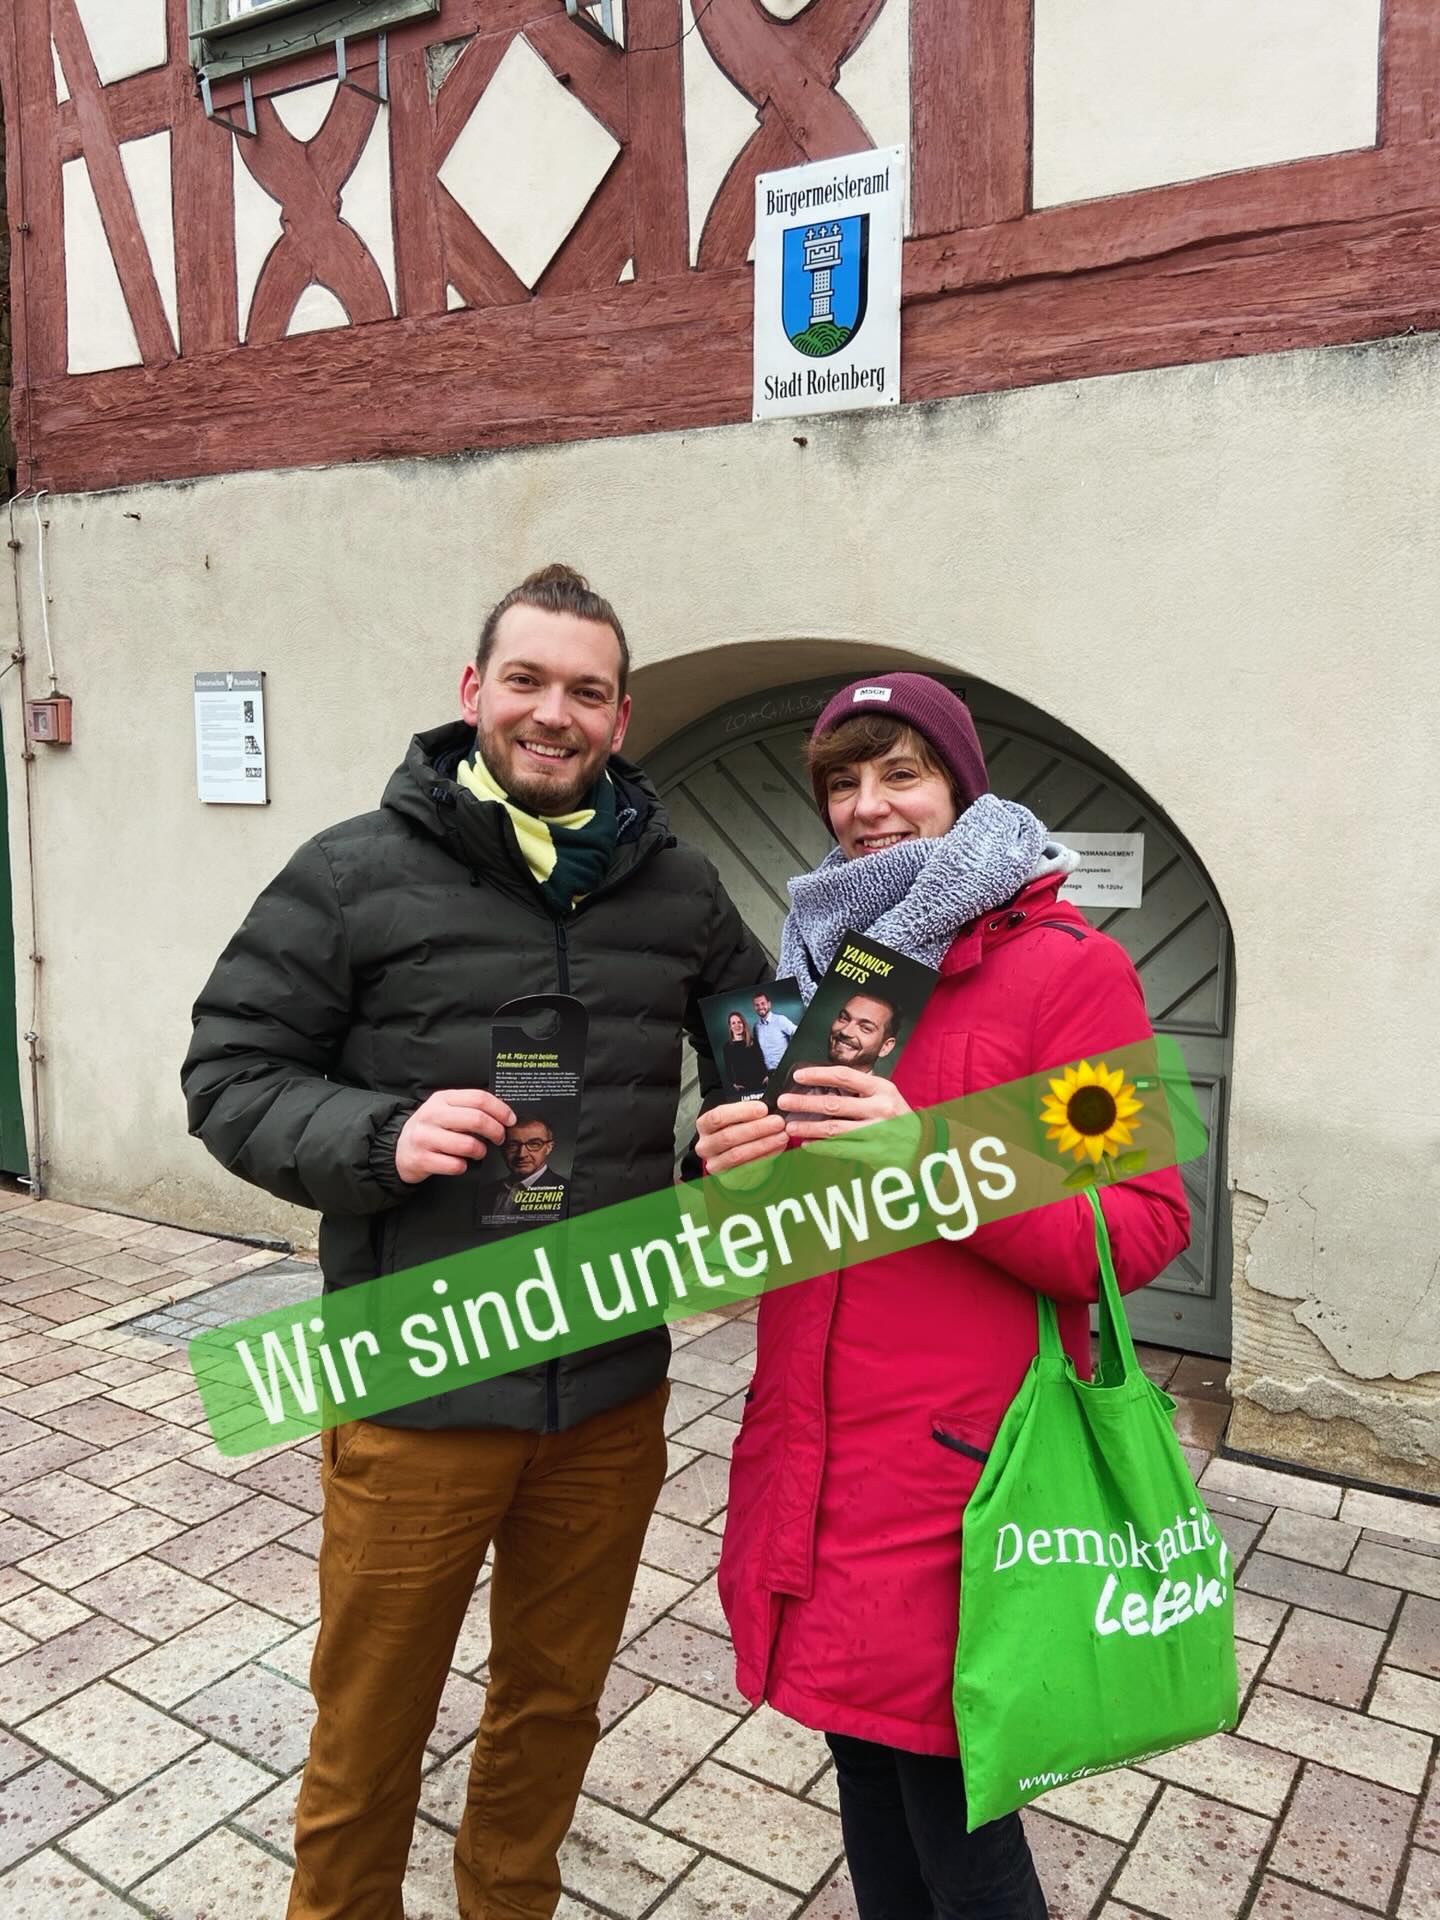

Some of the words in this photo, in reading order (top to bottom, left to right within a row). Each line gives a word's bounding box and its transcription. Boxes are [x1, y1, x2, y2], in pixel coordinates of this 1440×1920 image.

[766, 168, 890, 217] Bürgermeisteramt
[764, 370, 803, 401] Stadt
[807, 364, 886, 395] Rotenberg
[834, 959, 871, 985] VEITS
[841, 944, 894, 977] YANNICK
[514, 1190, 564, 1204] ÖZDEMIR
[993, 1507, 1216, 1573] Demokratie
